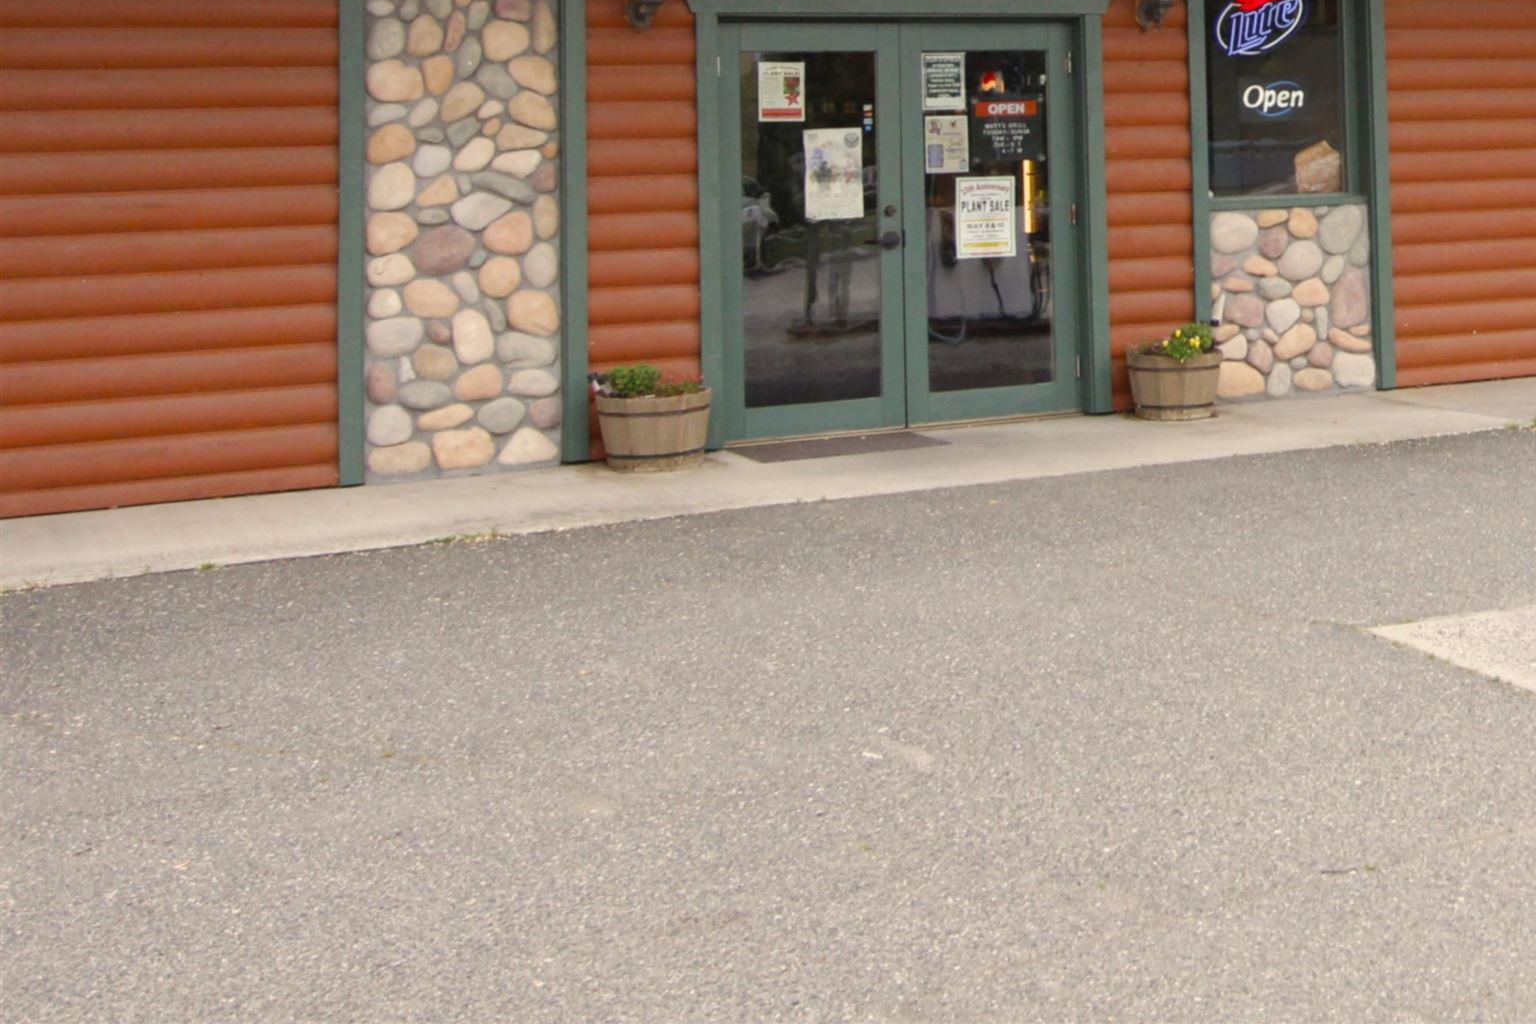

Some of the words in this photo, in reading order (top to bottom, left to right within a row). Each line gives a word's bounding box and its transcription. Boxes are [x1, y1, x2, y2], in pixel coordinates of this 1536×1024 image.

[1243, 84, 1304, 113] Open
[988, 102, 1025, 115] OPEN
[961, 200, 986, 213] PLANT
[990, 199, 1010, 212] SALE
